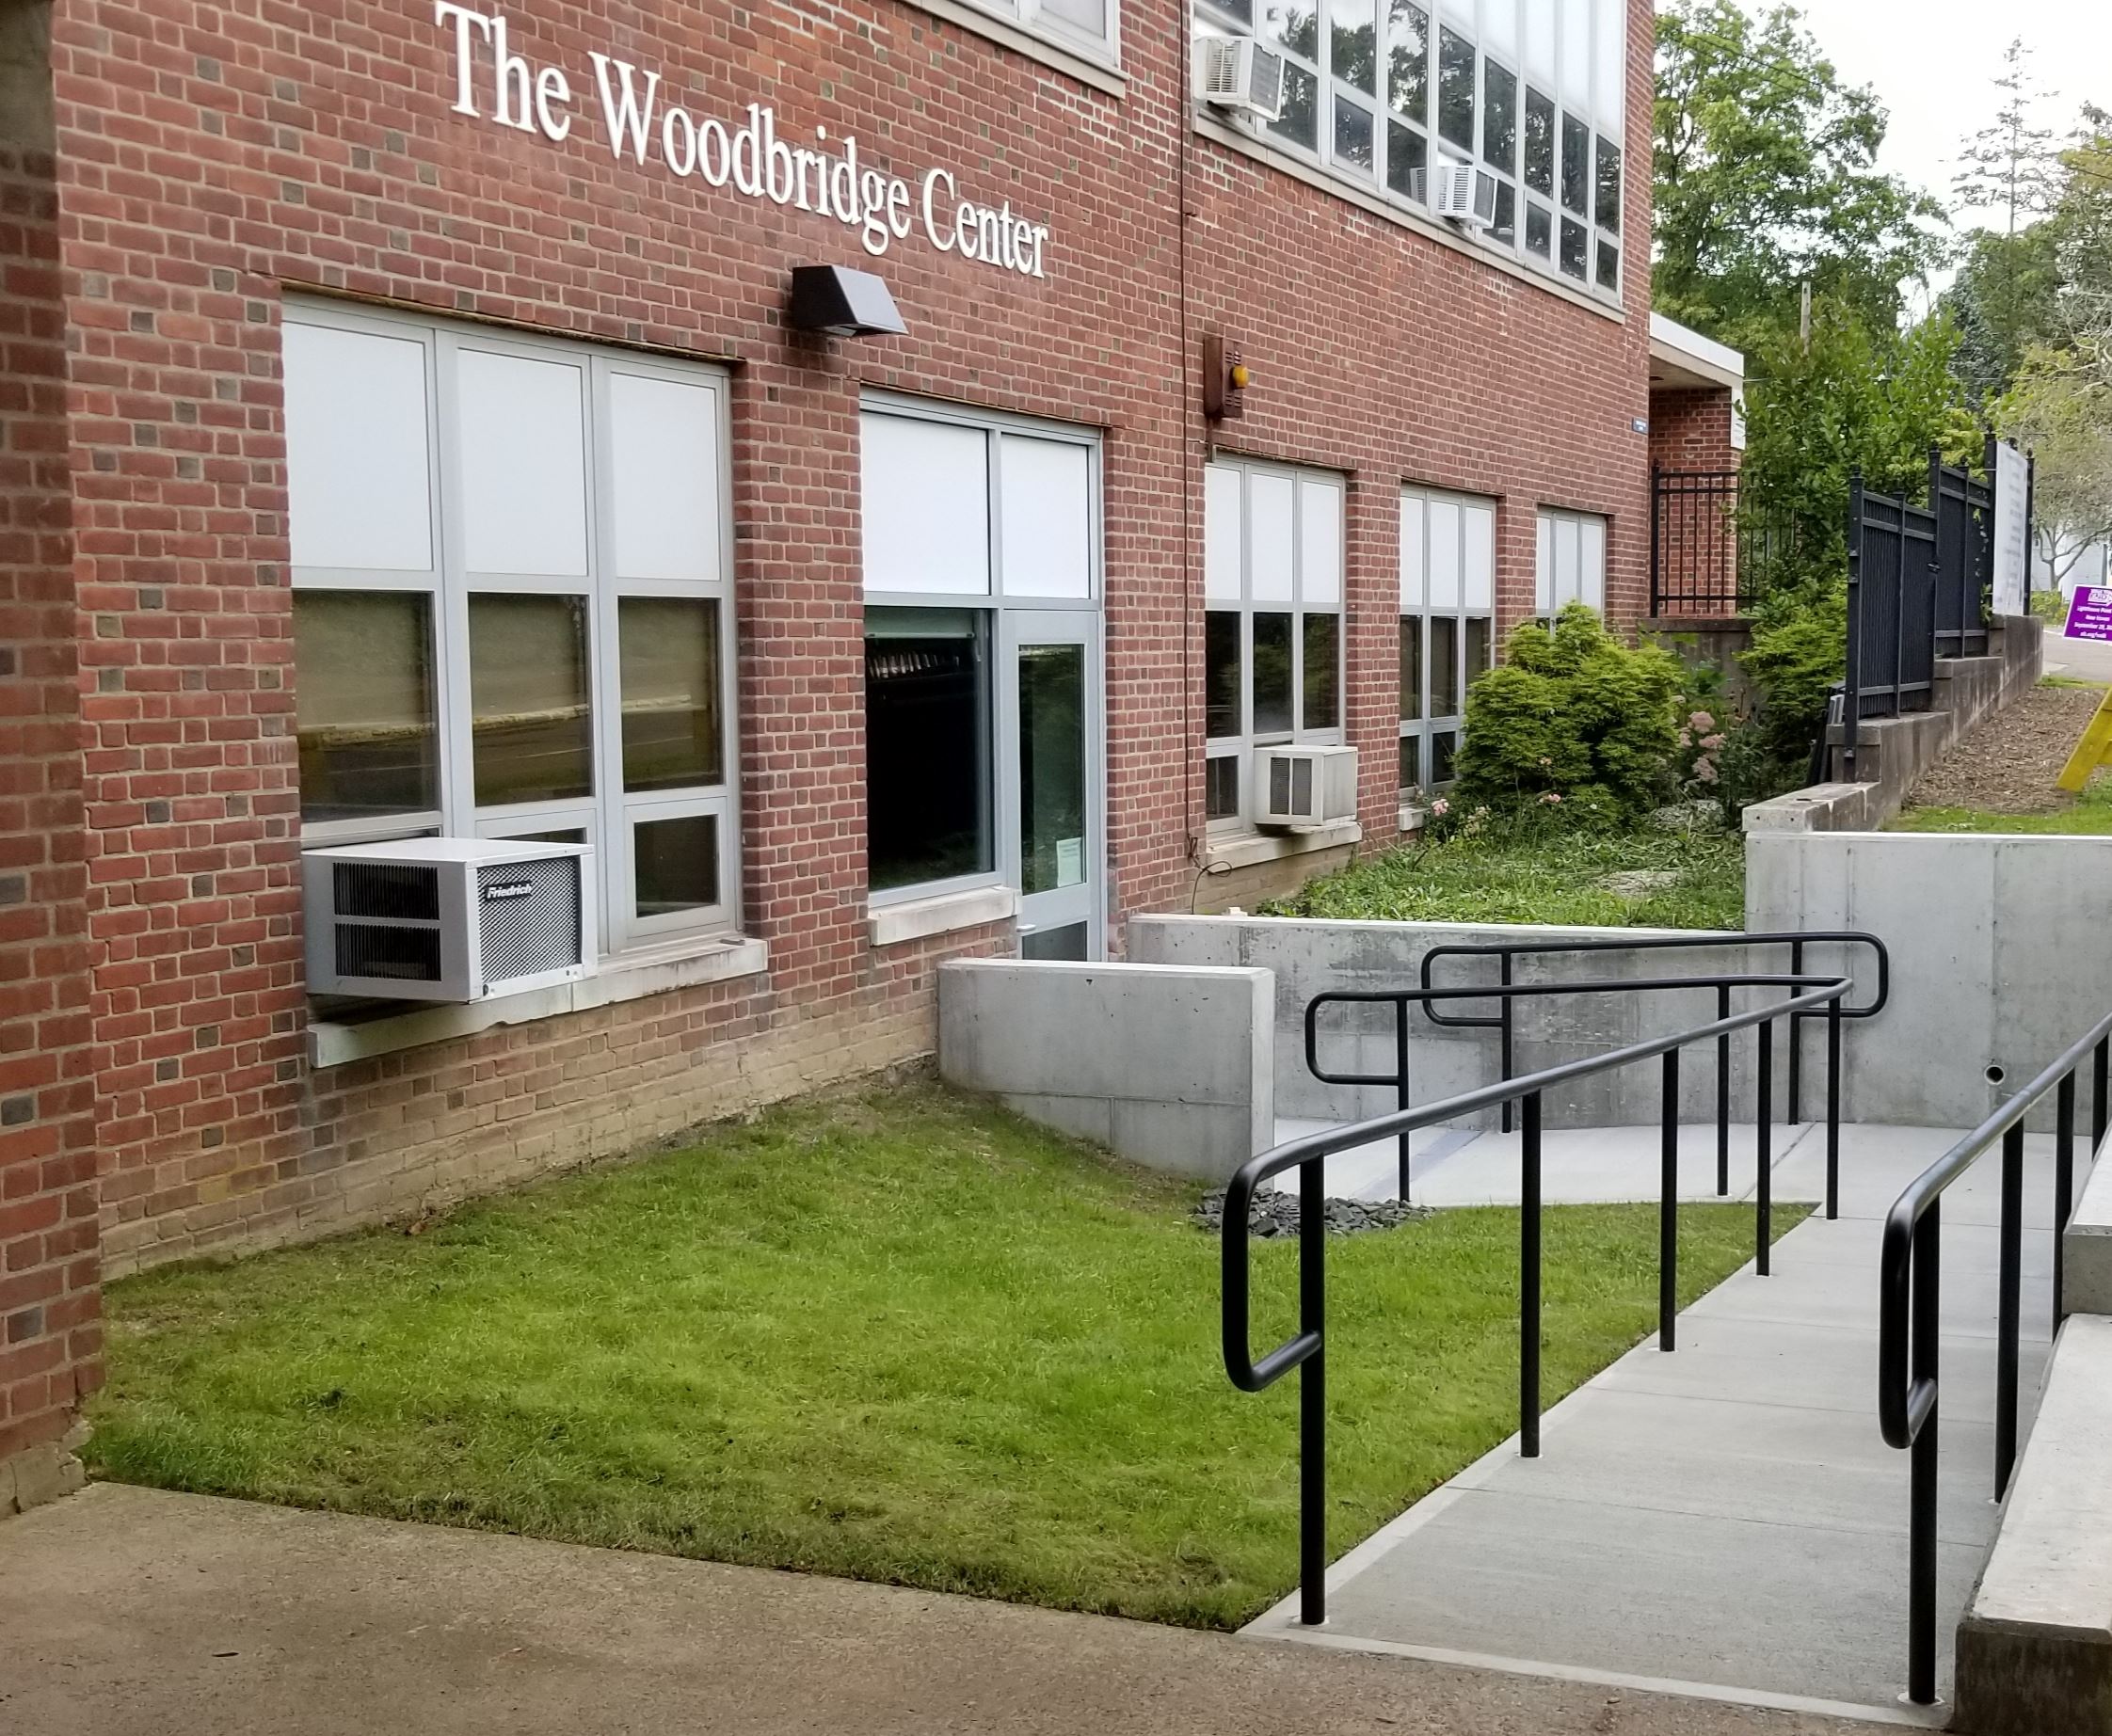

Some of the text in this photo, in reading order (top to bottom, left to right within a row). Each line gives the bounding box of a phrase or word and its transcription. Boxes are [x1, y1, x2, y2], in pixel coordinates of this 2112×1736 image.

[435, 1, 1048, 279] The Woodbridge Center
[487, 884, 533, 899] Friedrich
